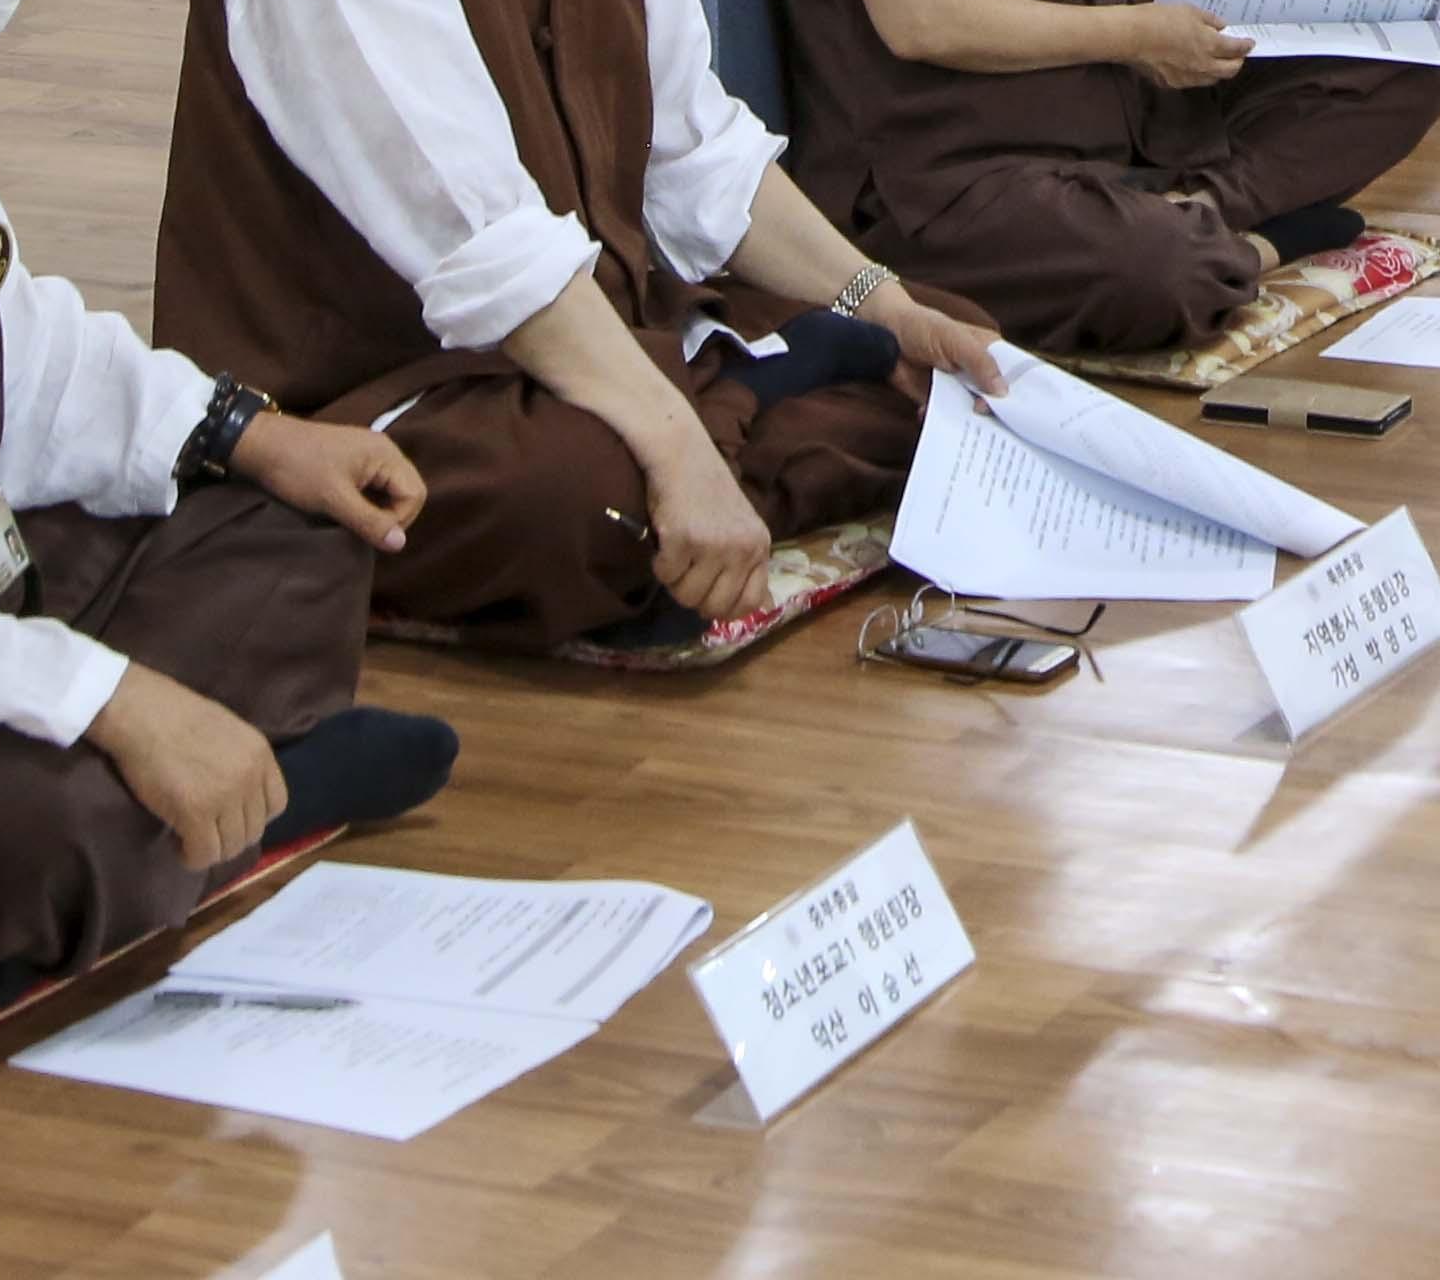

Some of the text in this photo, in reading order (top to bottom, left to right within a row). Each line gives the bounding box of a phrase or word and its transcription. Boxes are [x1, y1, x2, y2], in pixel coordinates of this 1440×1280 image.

[1303, 570, 1411, 655] 지역봉사 동행팀장
[1331, 654, 1361, 689] 기성
[1365, 638, 1383, 665] 박
